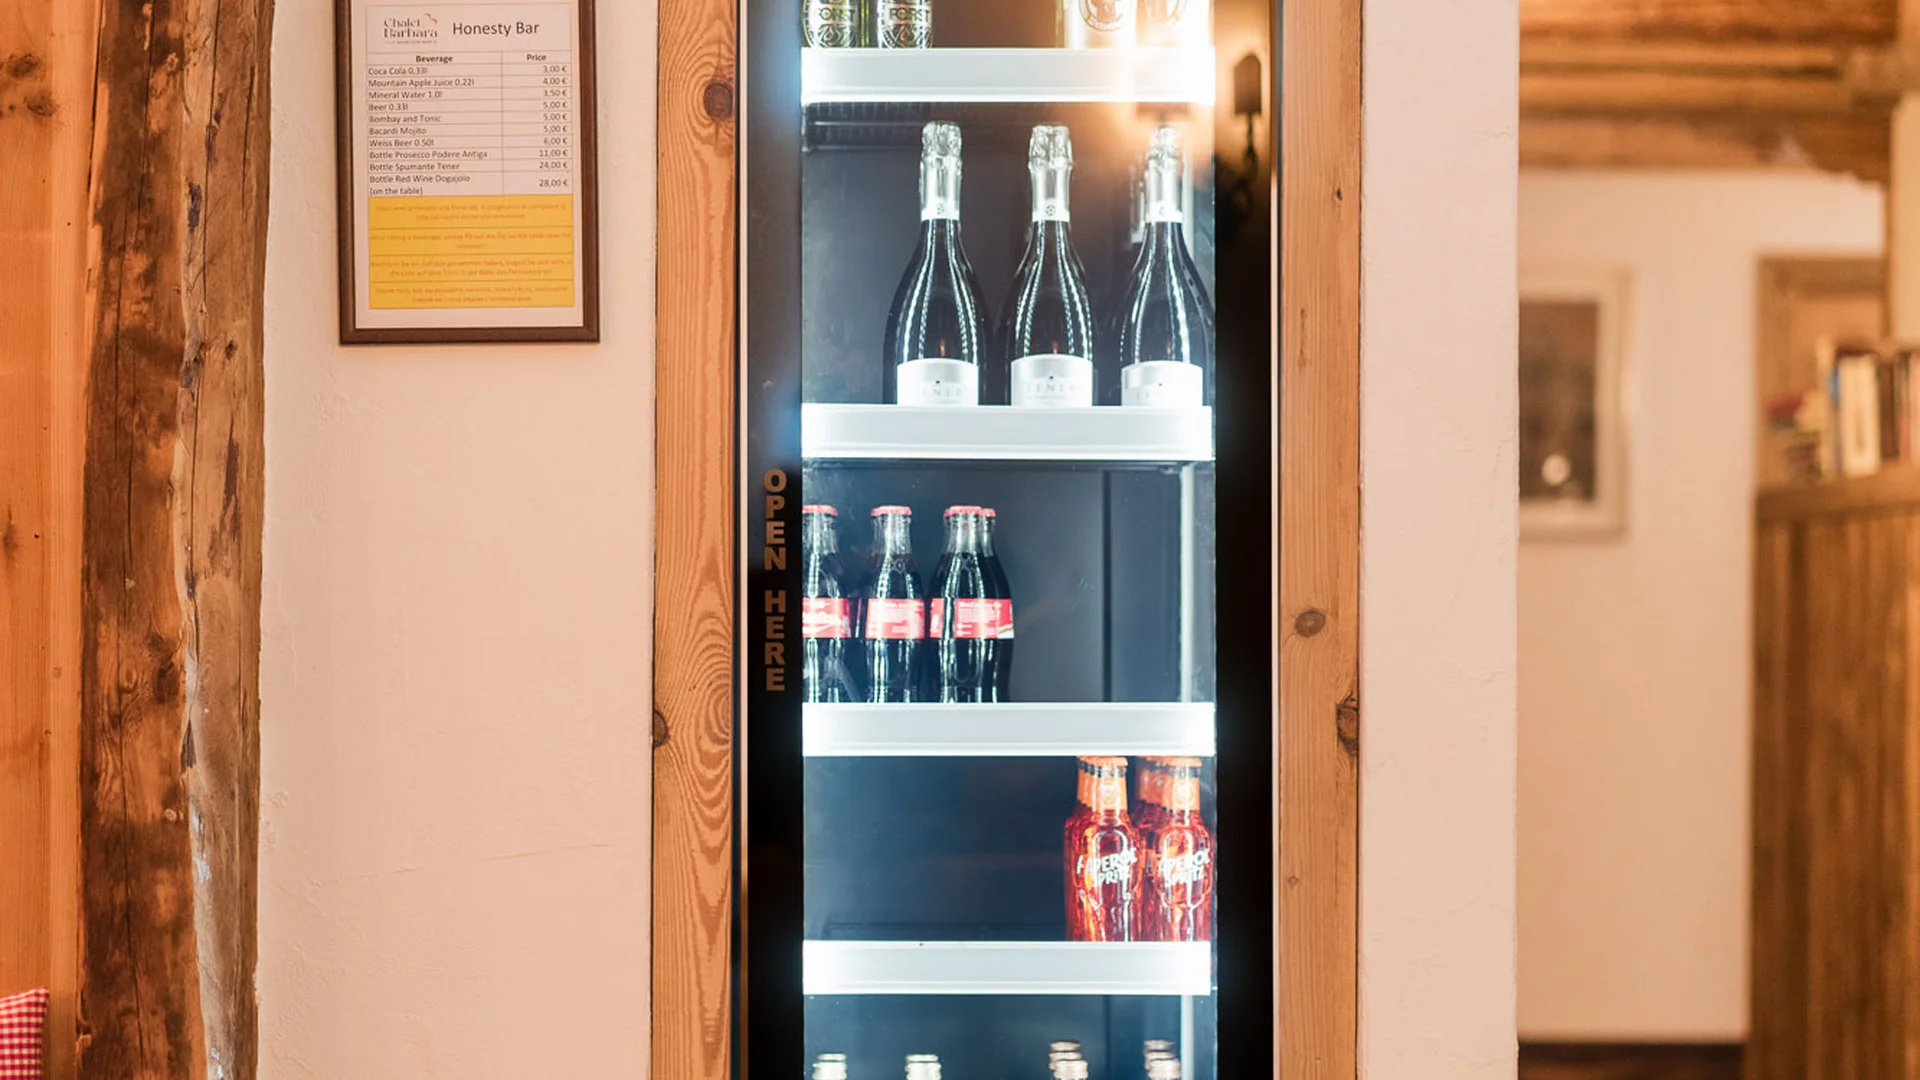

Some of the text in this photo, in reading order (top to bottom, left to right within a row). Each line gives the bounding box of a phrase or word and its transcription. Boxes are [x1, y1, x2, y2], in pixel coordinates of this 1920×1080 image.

[383, 17, 421, 28] Chalet
[383, 28, 438, 38] Barbara
[452, 21, 540, 38] Honesty Bar
[415, 55, 453, 64] Beverage
[526, 53, 547, 62] Price
[368, 67, 388, 75] Coca
[389, 66, 407, 75] Cola
[368, 79, 407, 88] Mountain
[408, 79, 432, 88] Apple
[433, 79, 453, 87] Juice
[368, 91, 400, 100] Mineral
[401, 91, 426, 99] Water
[368, 103, 388, 111] Beer
[369, 115, 401, 124] Bombay
[402, 115, 419, 123] and
[369, 127, 427, 136] Bacardi Mojito
[369, 139, 393, 147] Weiss
[394, 139, 413, 147] Beer
[369, 150, 488, 159] Bottle Prosecco Podere Antiga
[369, 162, 460, 172] Bottle Spumante Tener
[369, 175, 394, 183] Bottle
[435, 174, 471, 184] Dogajolo
[369, 186, 423, 196] (on the table)
[764, 468, 788, 692] OPEN HERE
